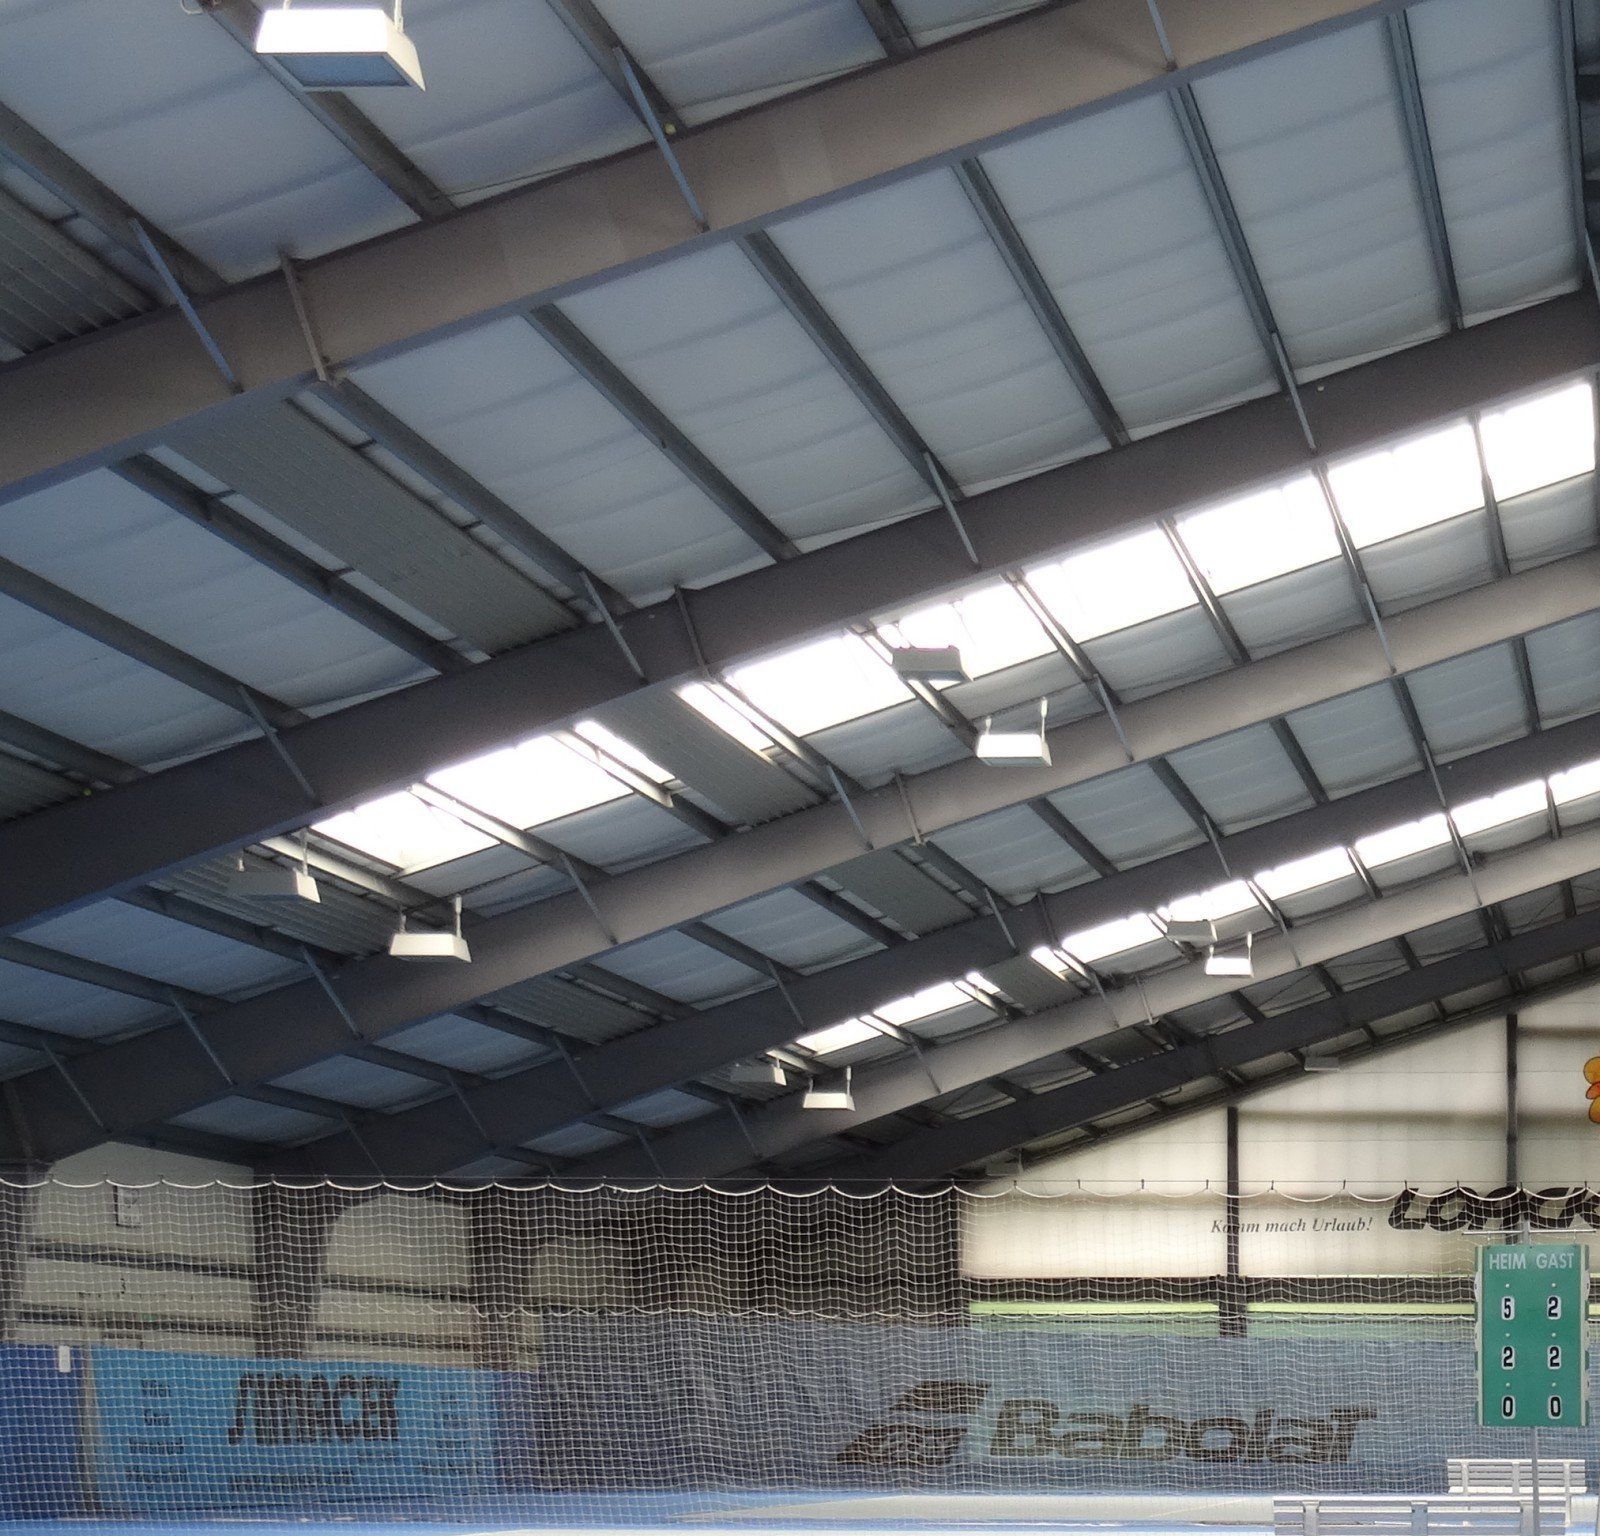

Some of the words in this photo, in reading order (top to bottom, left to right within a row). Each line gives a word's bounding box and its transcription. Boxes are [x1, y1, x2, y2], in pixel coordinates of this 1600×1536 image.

[1265, 1218, 1306, 1232] mach
[1312, 1216, 1373, 1232] Urlaub!
[1489, 1254, 1526, 1270] HEIM
[1536, 1253, 1575, 1269] GAST
[1504, 1298, 1511, 1318] 5
[1548, 1297, 1559, 1317] 2
[1503, 1347, 1513, 1367] 2
[1550, 1347, 1560, 1367] 2
[1503, 1396, 1513, 1417] 0
[1551, 1396, 1561, 1417] 0
